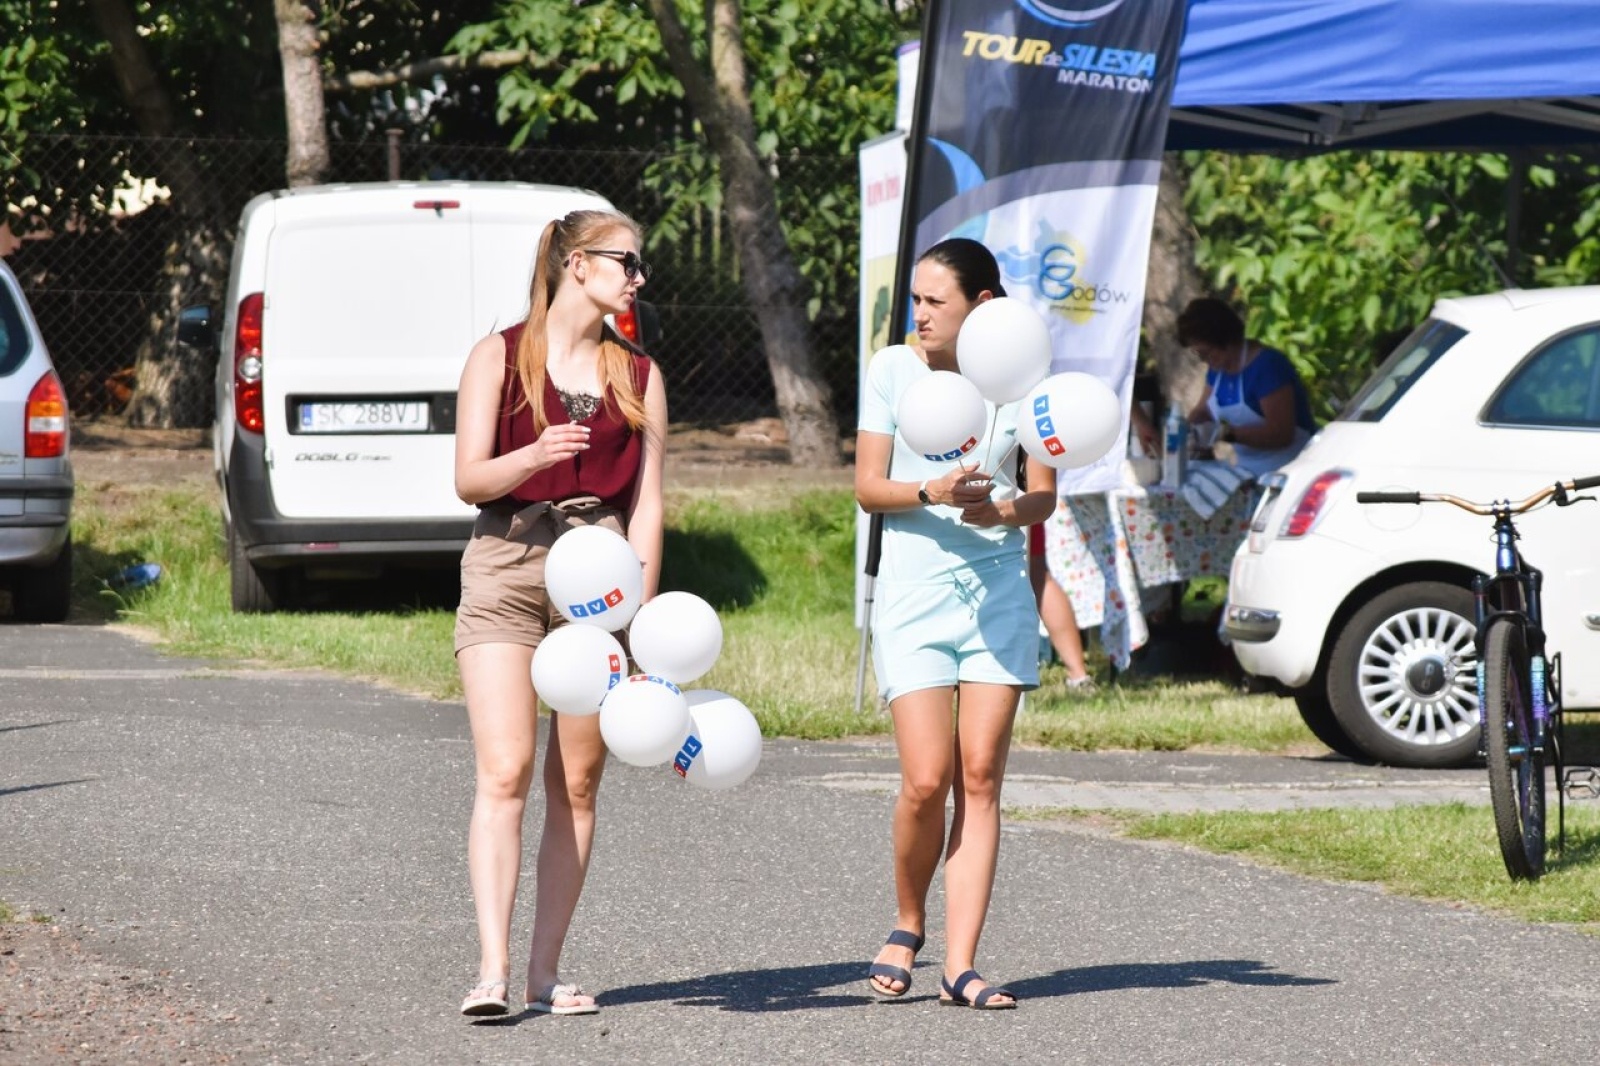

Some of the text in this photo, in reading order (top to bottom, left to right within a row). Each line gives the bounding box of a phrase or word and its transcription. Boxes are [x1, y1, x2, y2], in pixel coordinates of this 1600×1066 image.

[962, 31, 1051, 65] TOUR
[1061, 43, 1157, 77] SILESIA
[1057, 69, 1157, 93] MARATON
[318, 402, 421, 425] SK 288VJ
[1034, 396, 1065, 455] TVS
[569, 589, 623, 616] TVS
[674, 737, 701, 778] TVS
